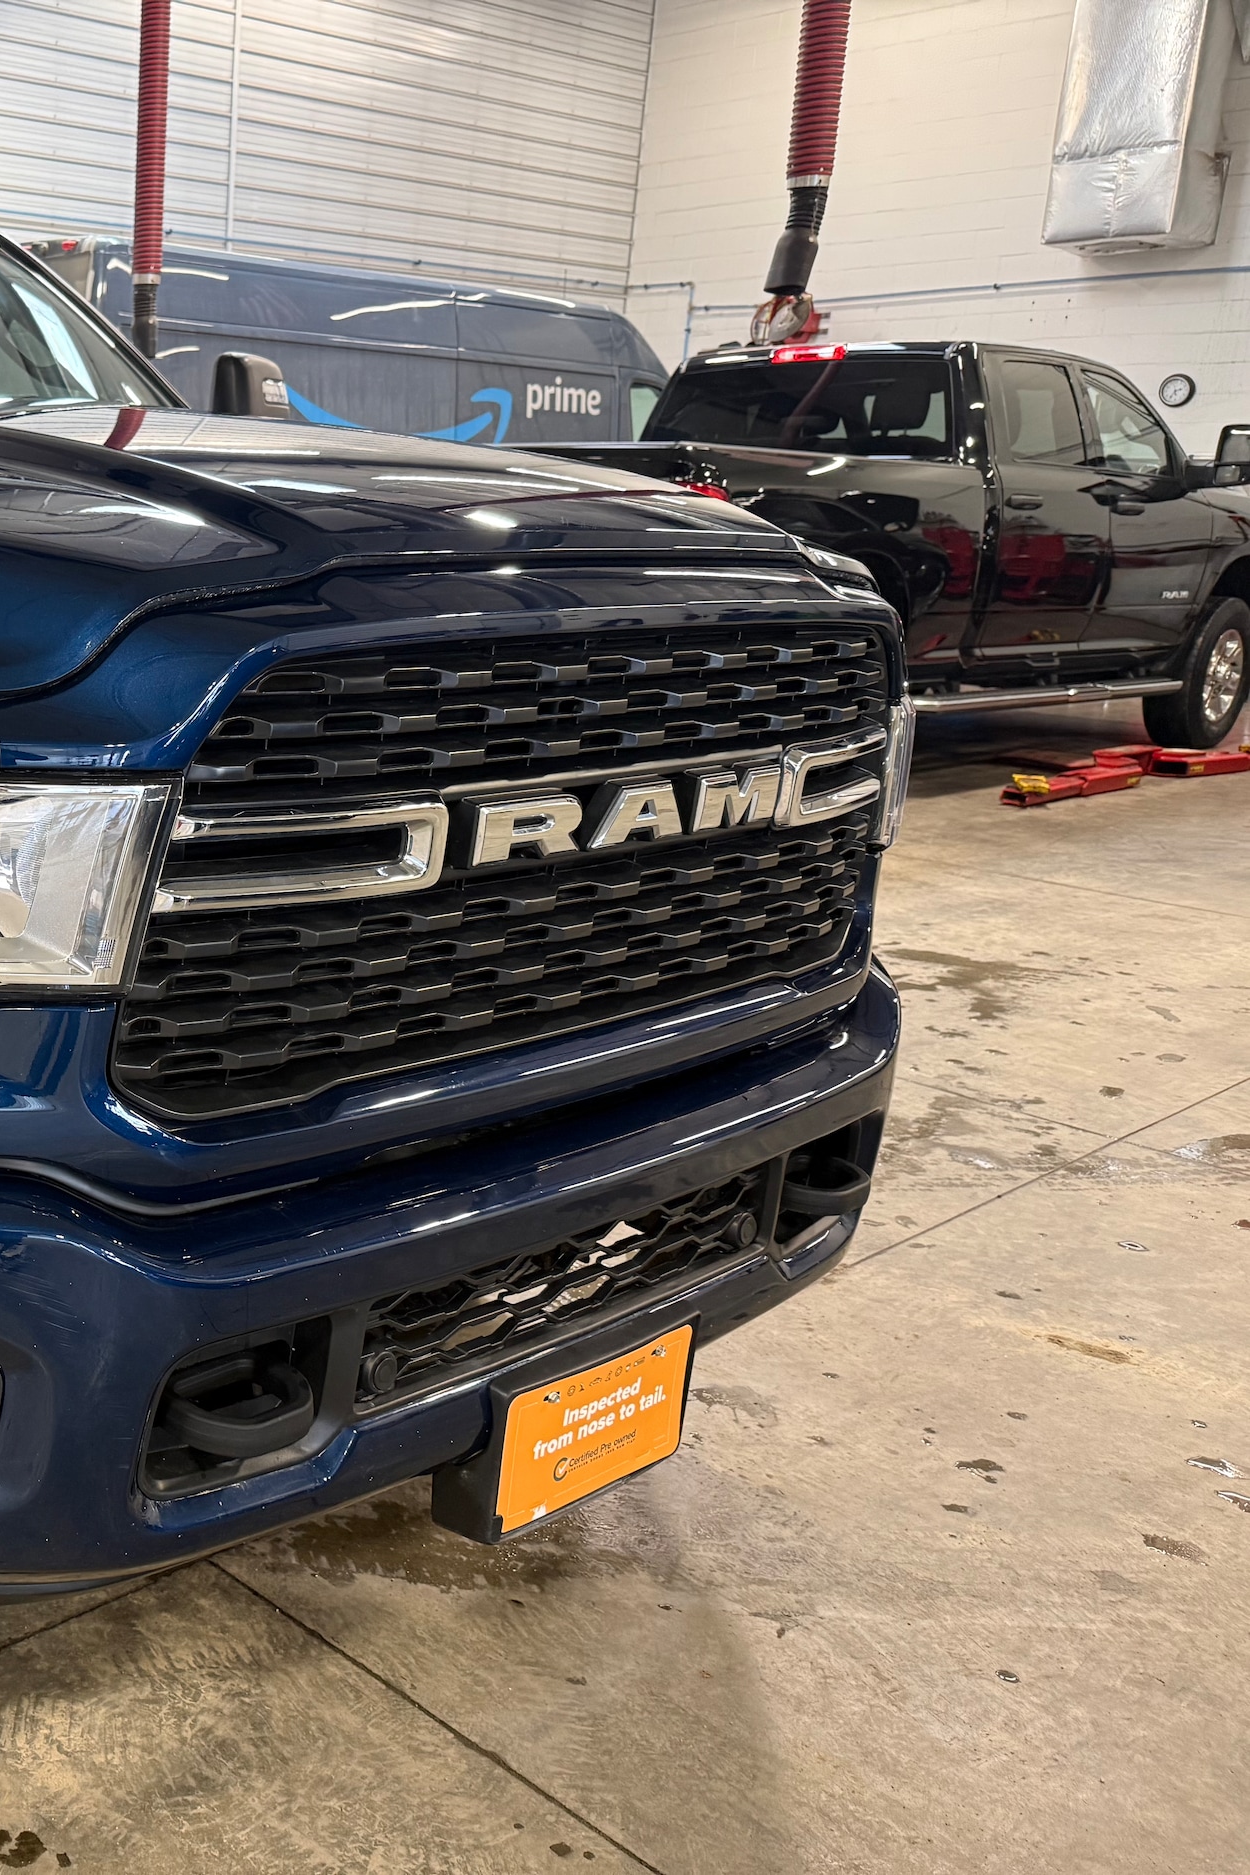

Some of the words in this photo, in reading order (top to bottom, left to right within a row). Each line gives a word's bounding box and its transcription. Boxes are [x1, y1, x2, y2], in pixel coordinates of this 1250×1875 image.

[526, 376, 601, 419] prime
[1161, 590, 1189, 599] RAM
[467, 766, 781, 868] RAM
[533, 1430, 573, 1460] from
[577, 1411, 615, 1440] nose
[619, 1402, 635, 1420] to
[639, 1384, 666, 1411] tail.
[562, 1376, 642, 1427] Inspected
[569, 1447, 598, 1467] Certified
[600, 1442, 611, 1452] Pre
[613, 1429, 636, 1446] owned
